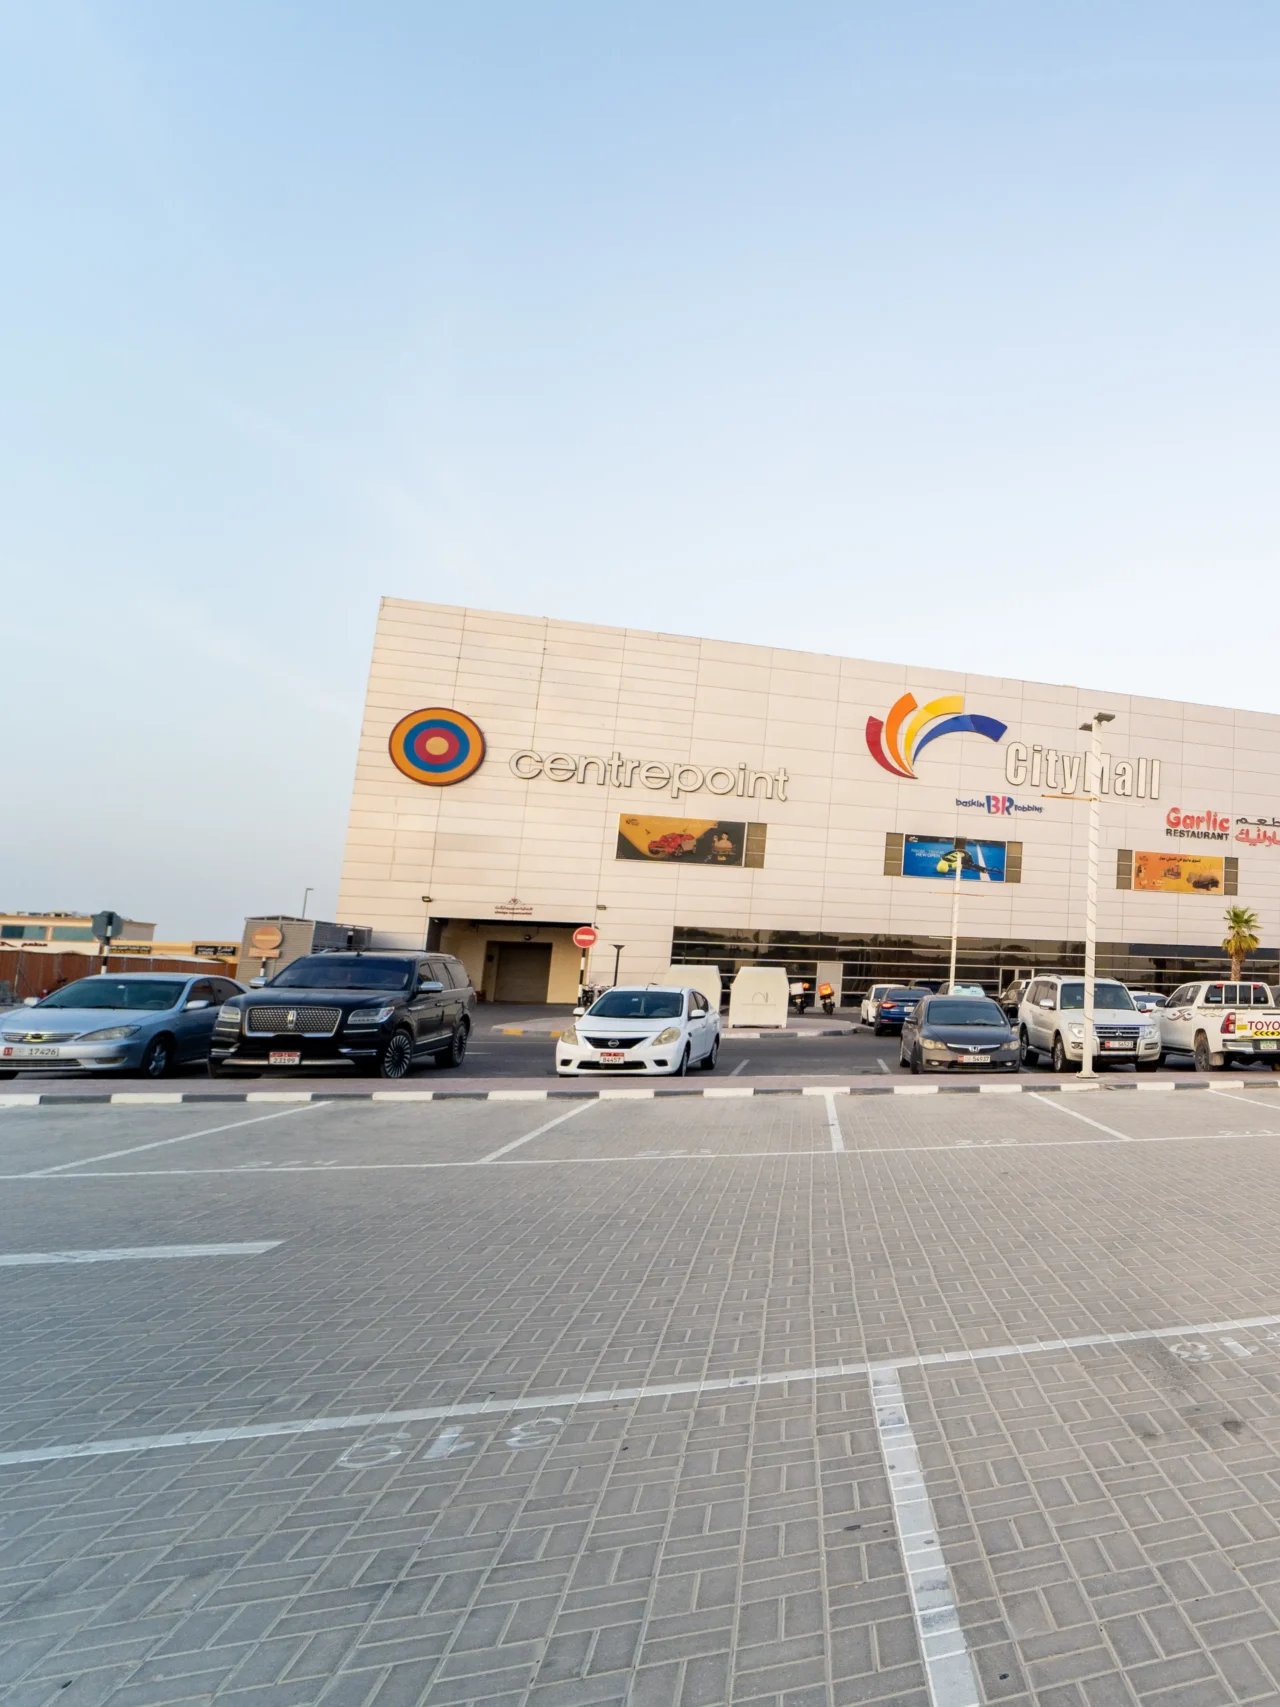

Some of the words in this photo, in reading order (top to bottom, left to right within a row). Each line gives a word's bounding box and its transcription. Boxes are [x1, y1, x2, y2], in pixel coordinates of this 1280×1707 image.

[508, 749, 789, 802] centrepoint
[956, 798, 985, 808] baskin
[985, 795, 1015, 815] BR
[1015, 804, 1044, 813] robbins
[1166, 807, 1230, 832] Garlic
[1165, 828, 1230, 841] RESTAURANT
[28, 1048, 56, 1056] 17426
[337, 1416, 565, 1469] 319
